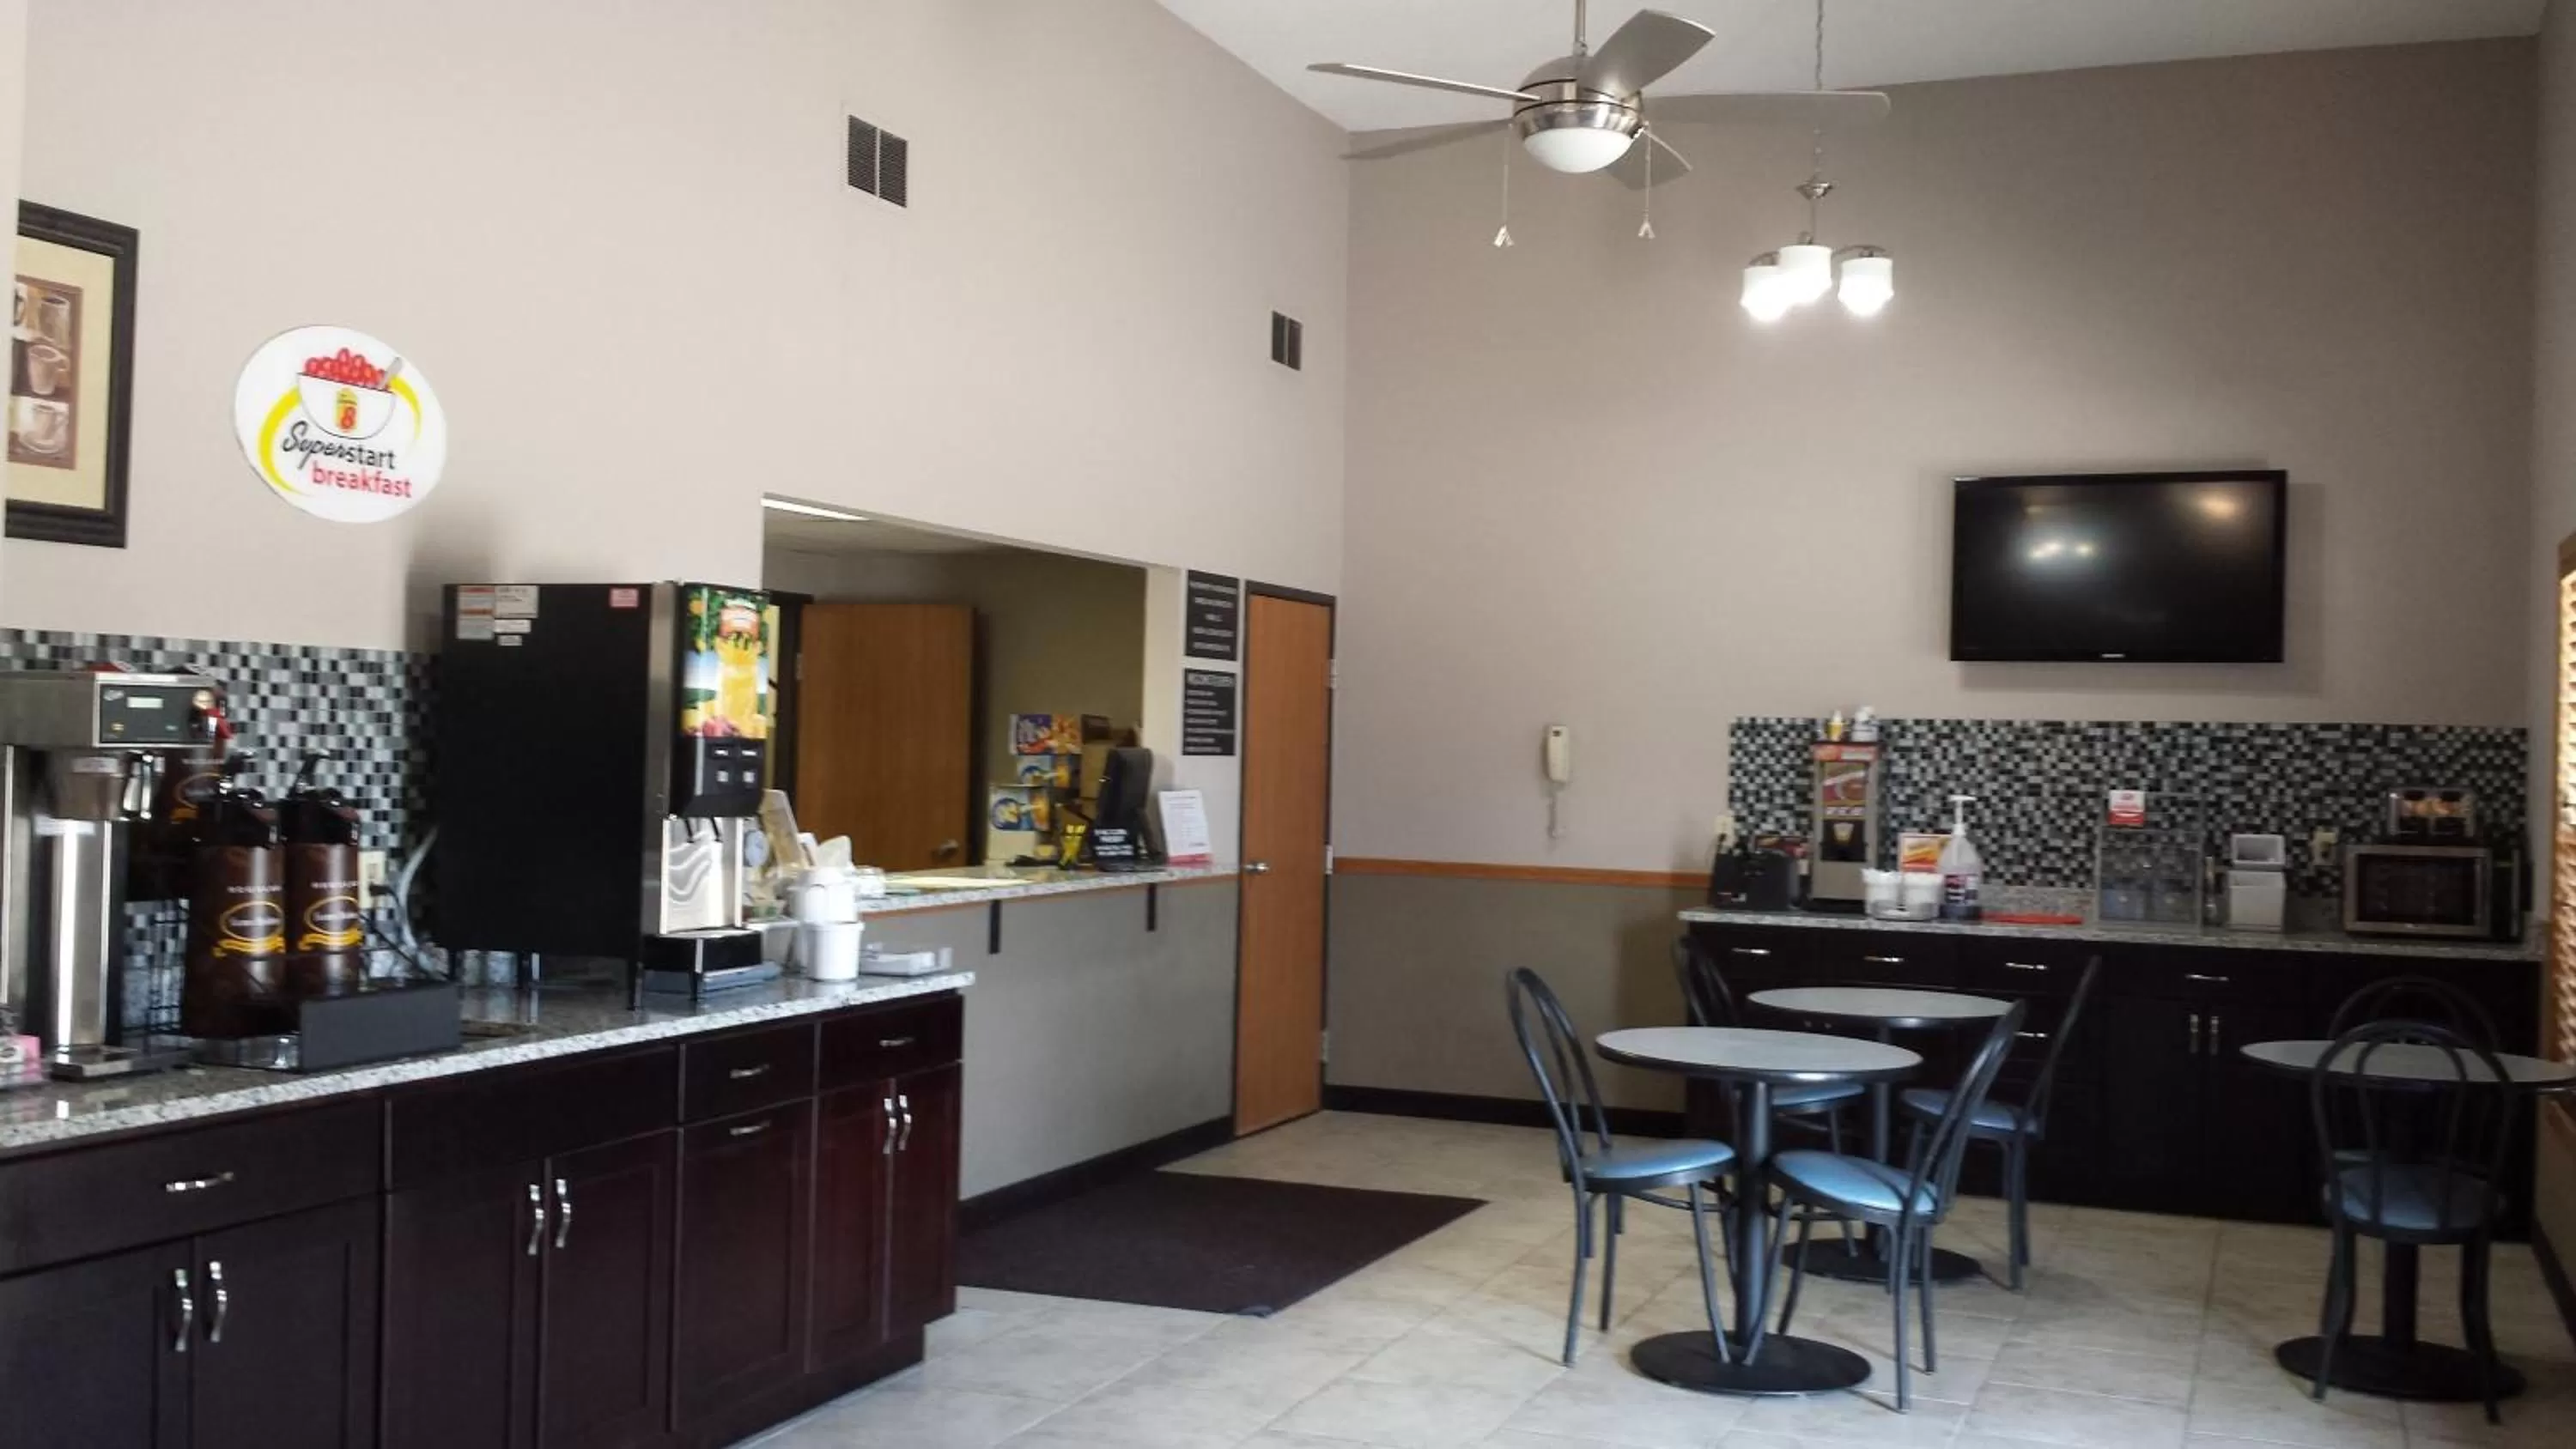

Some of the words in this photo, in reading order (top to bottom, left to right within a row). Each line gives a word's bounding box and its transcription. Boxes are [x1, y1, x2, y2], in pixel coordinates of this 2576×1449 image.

[340, 405, 356, 431] 8
[282, 420, 396, 470] Superstart
[312, 460, 412, 498] breakfast
